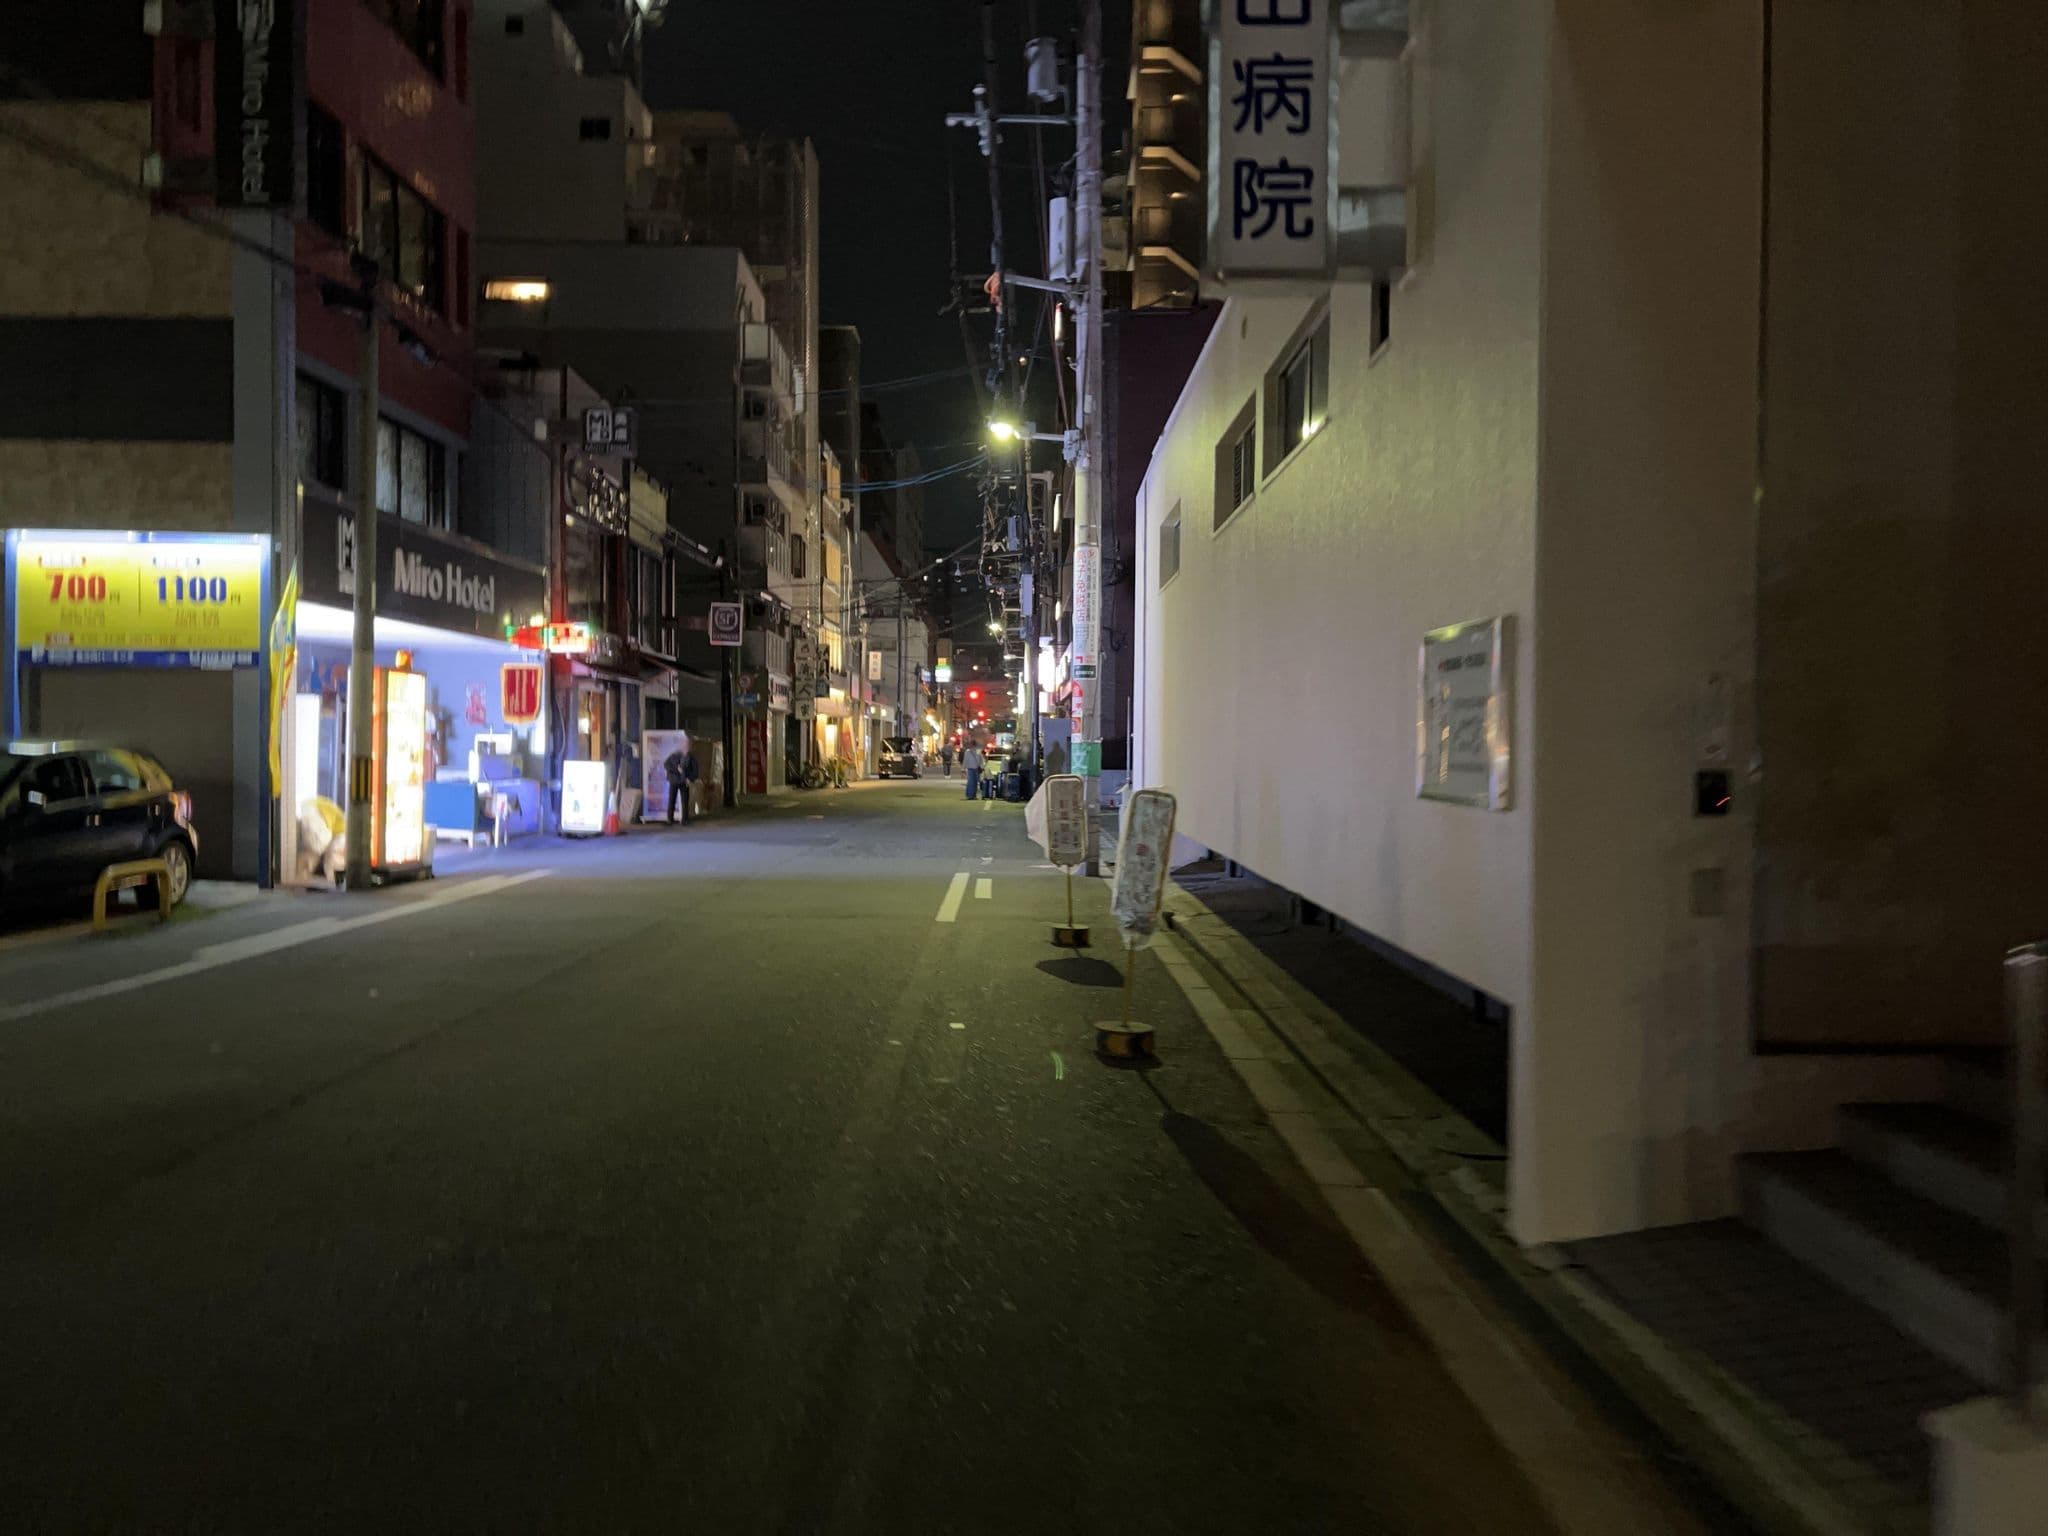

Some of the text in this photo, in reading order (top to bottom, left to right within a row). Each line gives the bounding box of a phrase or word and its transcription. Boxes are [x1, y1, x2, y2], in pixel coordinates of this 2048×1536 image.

[46, 571, 107, 604] 700
[155, 574, 227, 605] 1100
[394, 546, 495, 616] Miro Hotel
